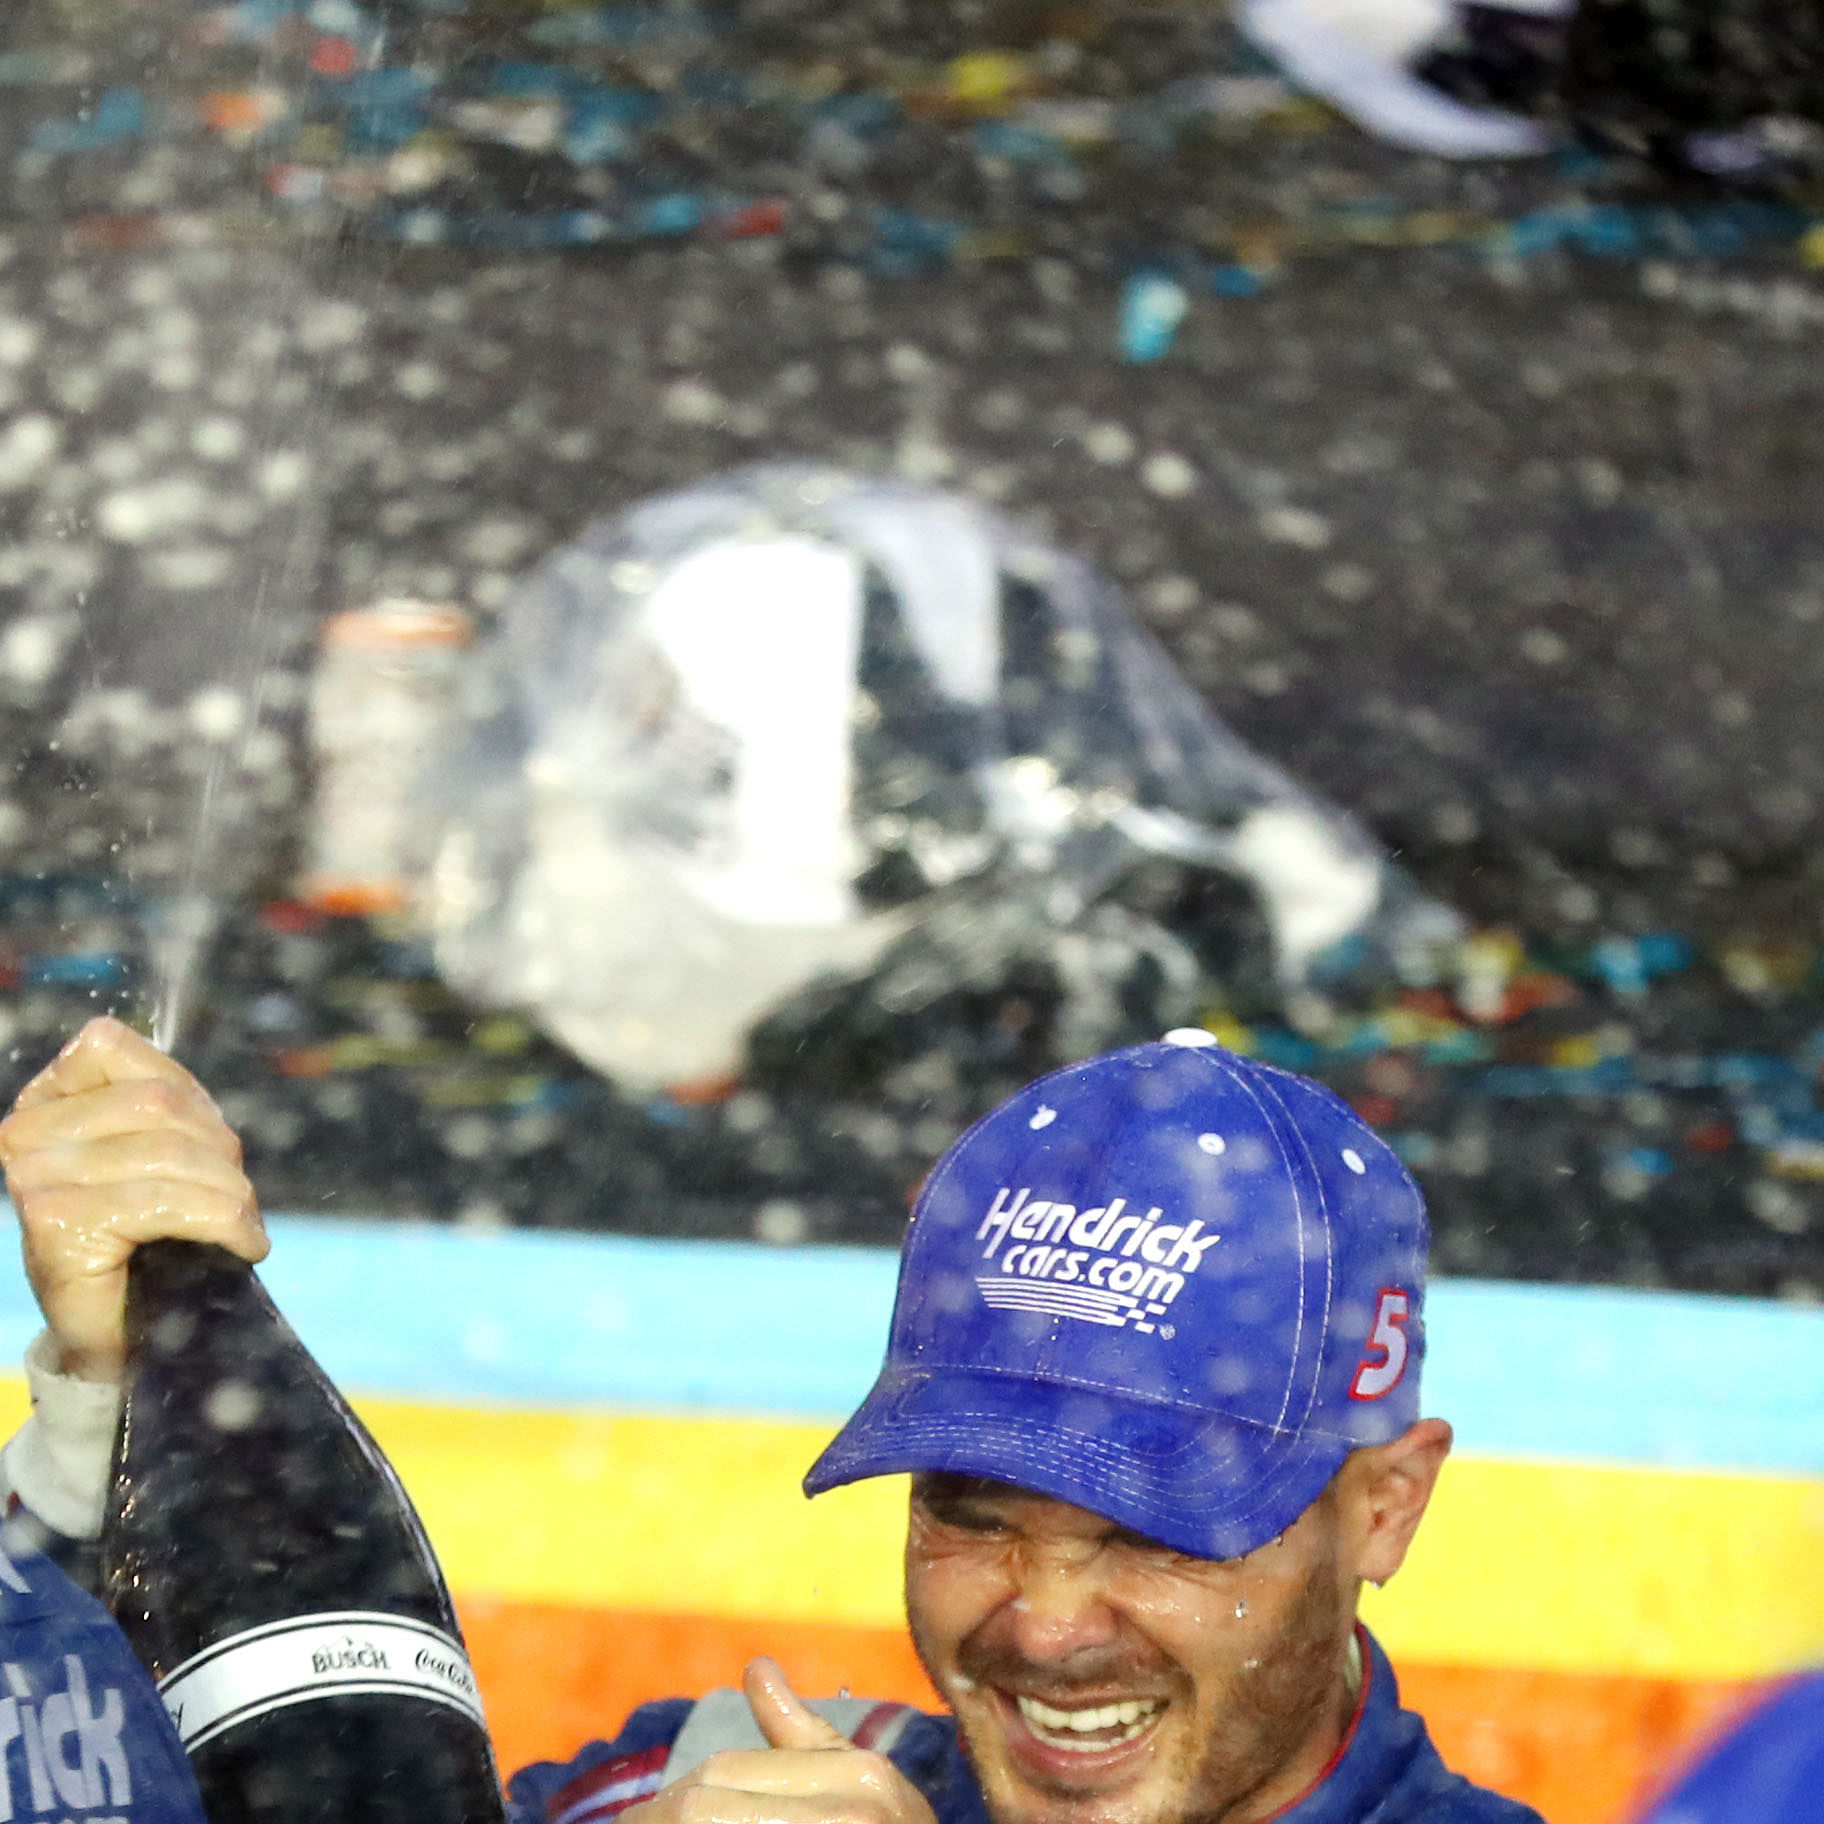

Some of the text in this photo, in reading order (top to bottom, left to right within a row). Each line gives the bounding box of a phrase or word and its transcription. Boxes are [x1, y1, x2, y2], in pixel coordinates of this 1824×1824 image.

[976, 1187, 1221, 1273] Hendrick
[1001, 1244, 1185, 1304] cars.com
[1350, 1289, 1408, 1400] 5
[310, 1648, 391, 1674] BUSCH
